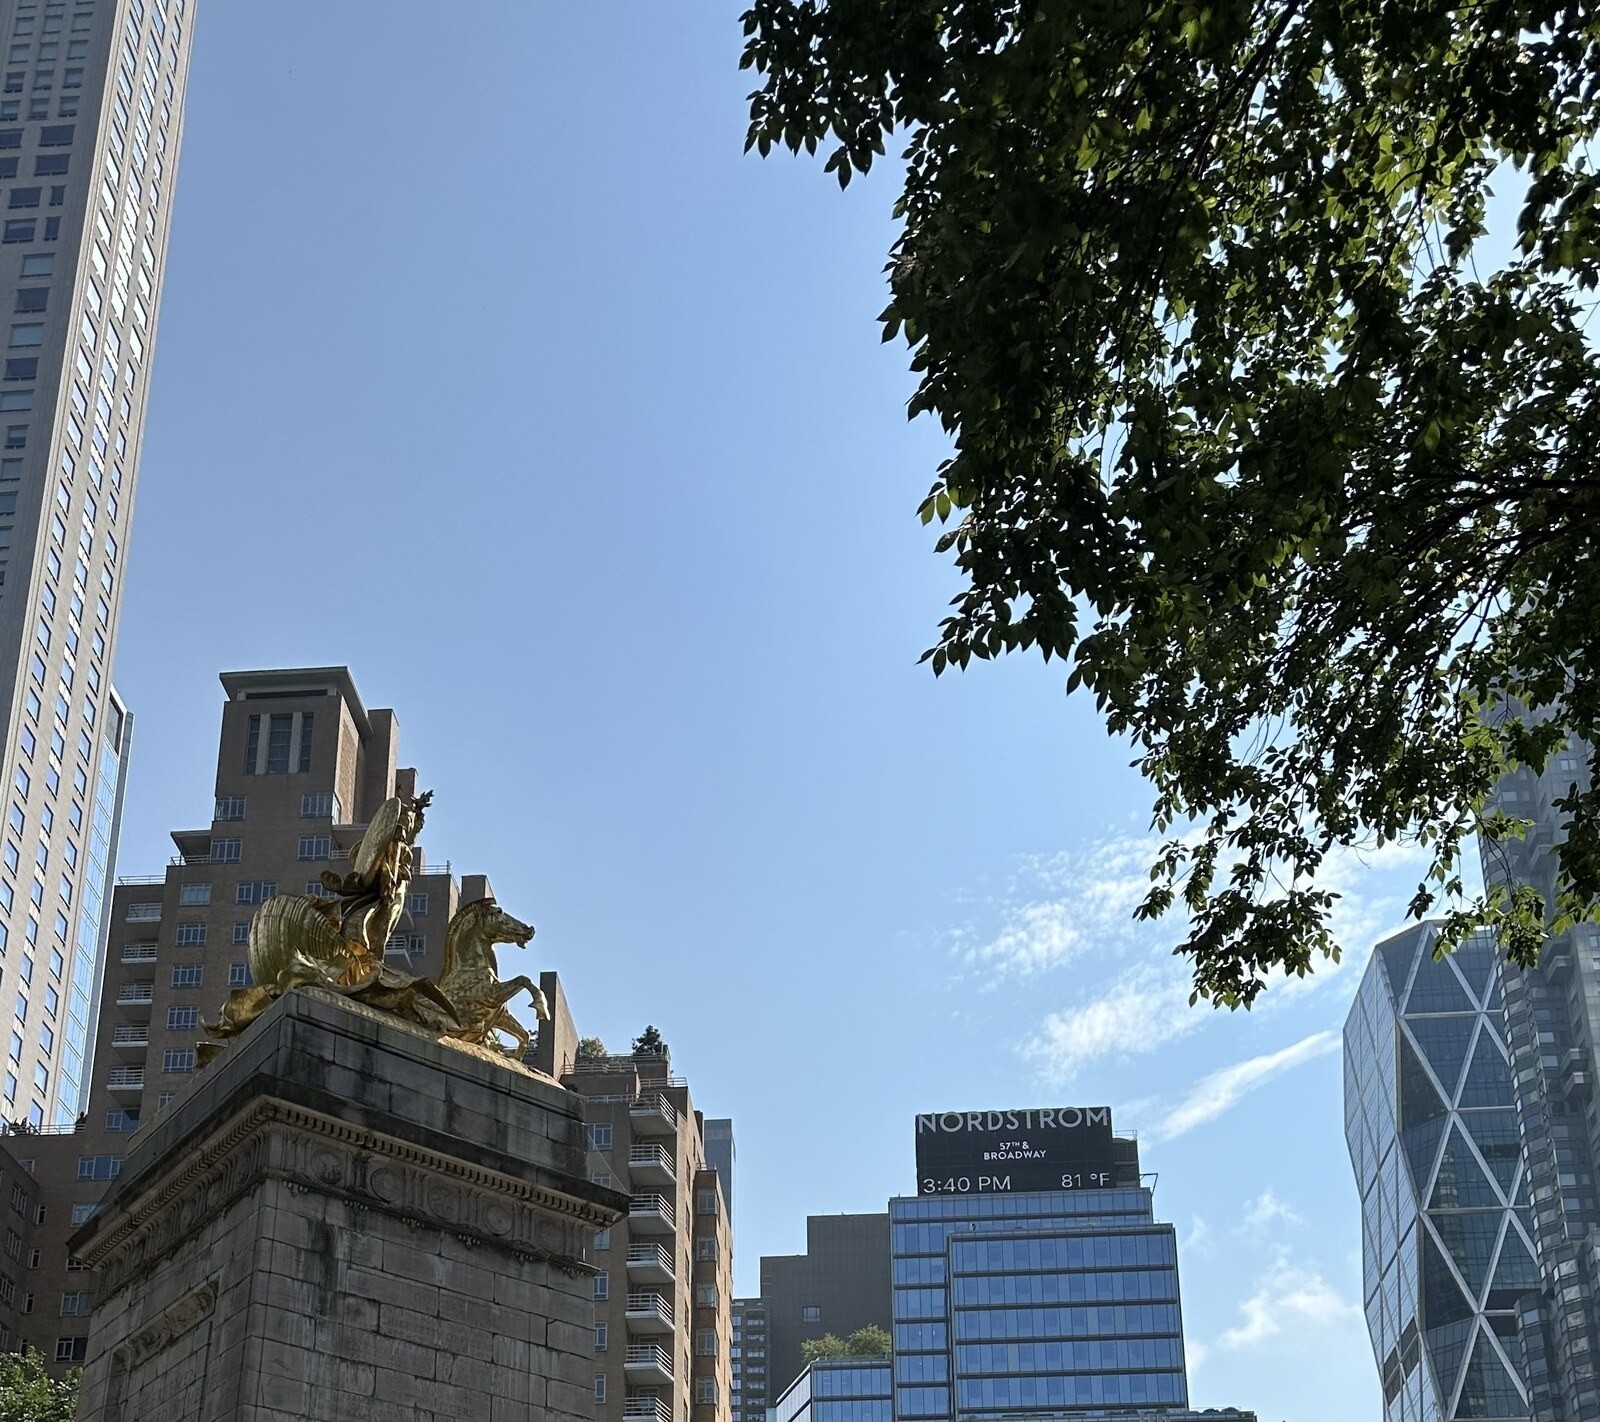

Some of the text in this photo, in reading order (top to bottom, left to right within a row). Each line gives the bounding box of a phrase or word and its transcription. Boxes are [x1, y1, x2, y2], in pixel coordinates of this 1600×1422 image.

[918, 1106, 1109, 1134] NORDSTROM
[999, 1141, 1030, 1150] 57TH &
[983, 1149, 1047, 1161] BROADWAY
[923, 1175, 1011, 1193] 3:40 PM
[1061, 1173, 1082, 1188] 81
